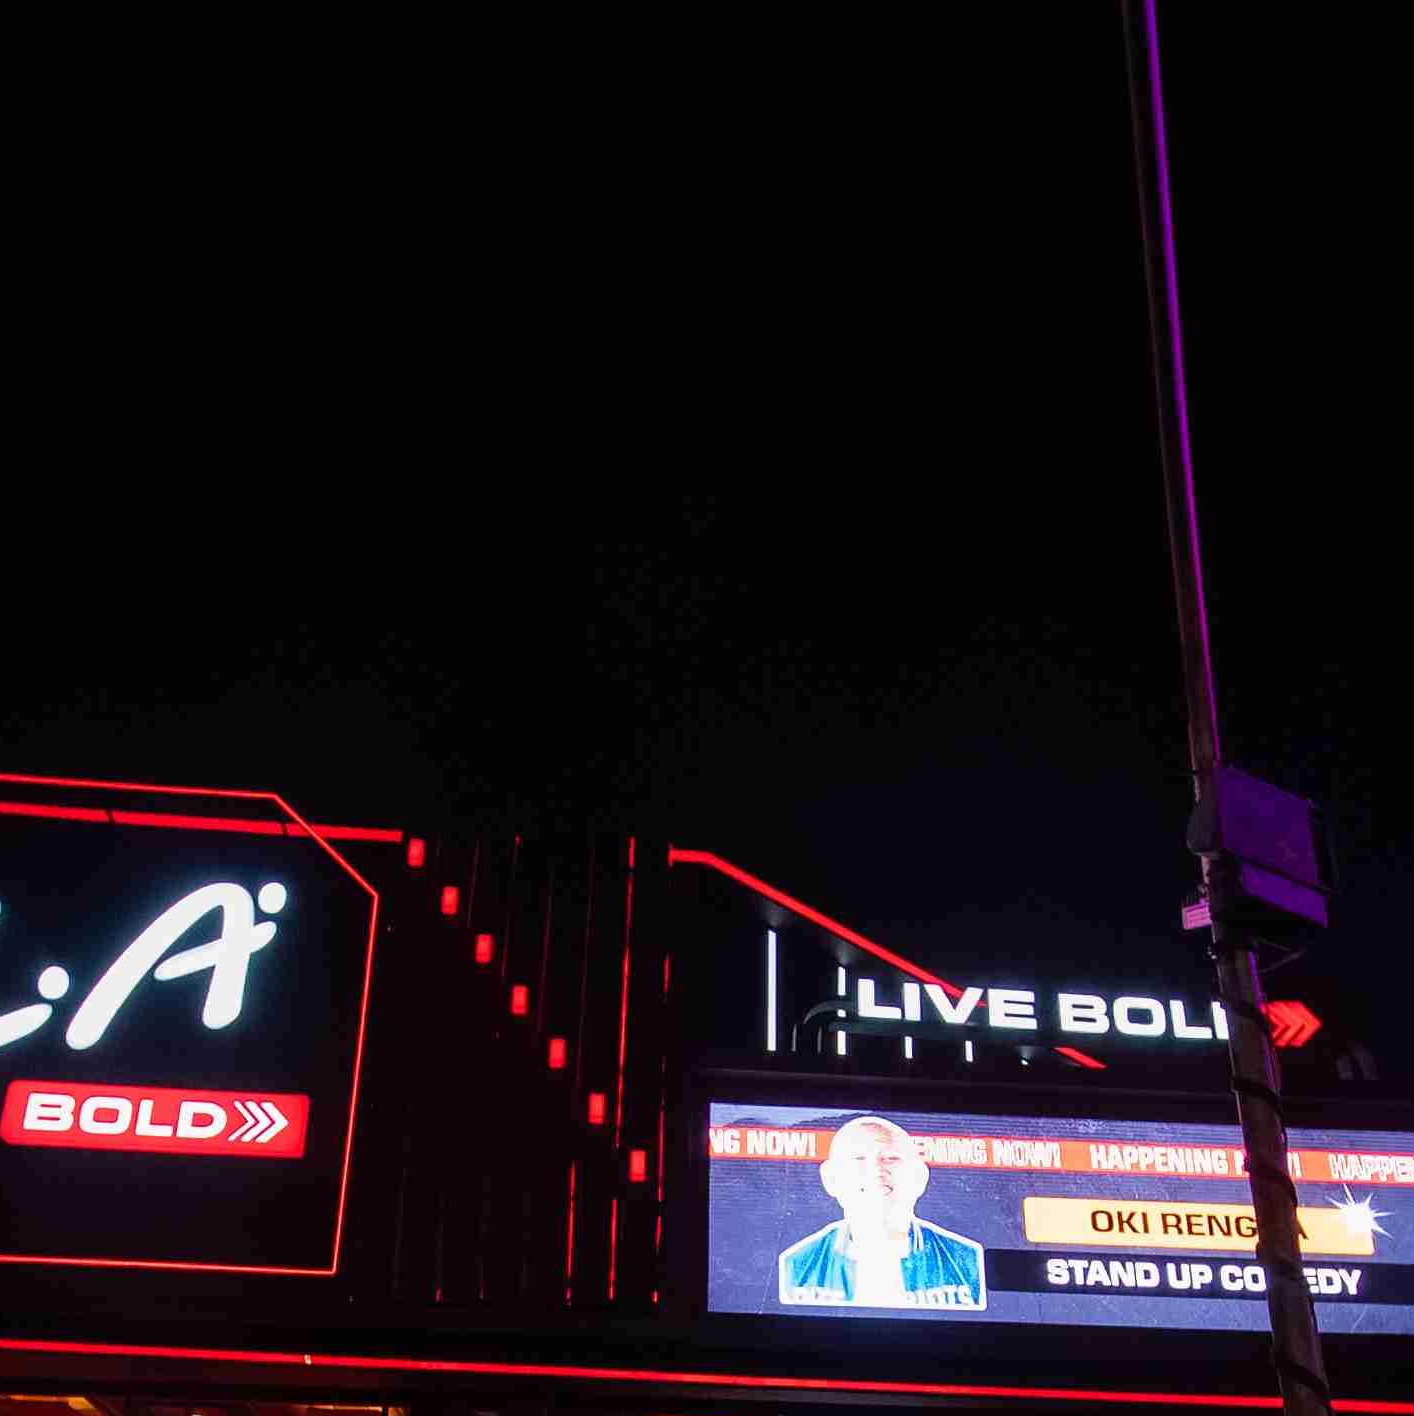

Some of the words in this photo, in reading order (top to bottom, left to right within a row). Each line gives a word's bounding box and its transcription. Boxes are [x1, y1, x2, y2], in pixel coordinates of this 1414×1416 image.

[856, 977, 1038, 1030] LIVE
[22, 1091, 228, 1140] BOLD
[746, 1129, 817, 1158] NOW!
[1089, 1143, 1228, 1175] HAPPENING
[1090, 1209, 1150, 1234] OKI
[1160, 1212, 1309, 1241] RENG
[1047, 1258, 1160, 1290] STAND
[1166, 1262, 1215, 1292] UP
[1219, 1264, 1362, 1296] COEDY
